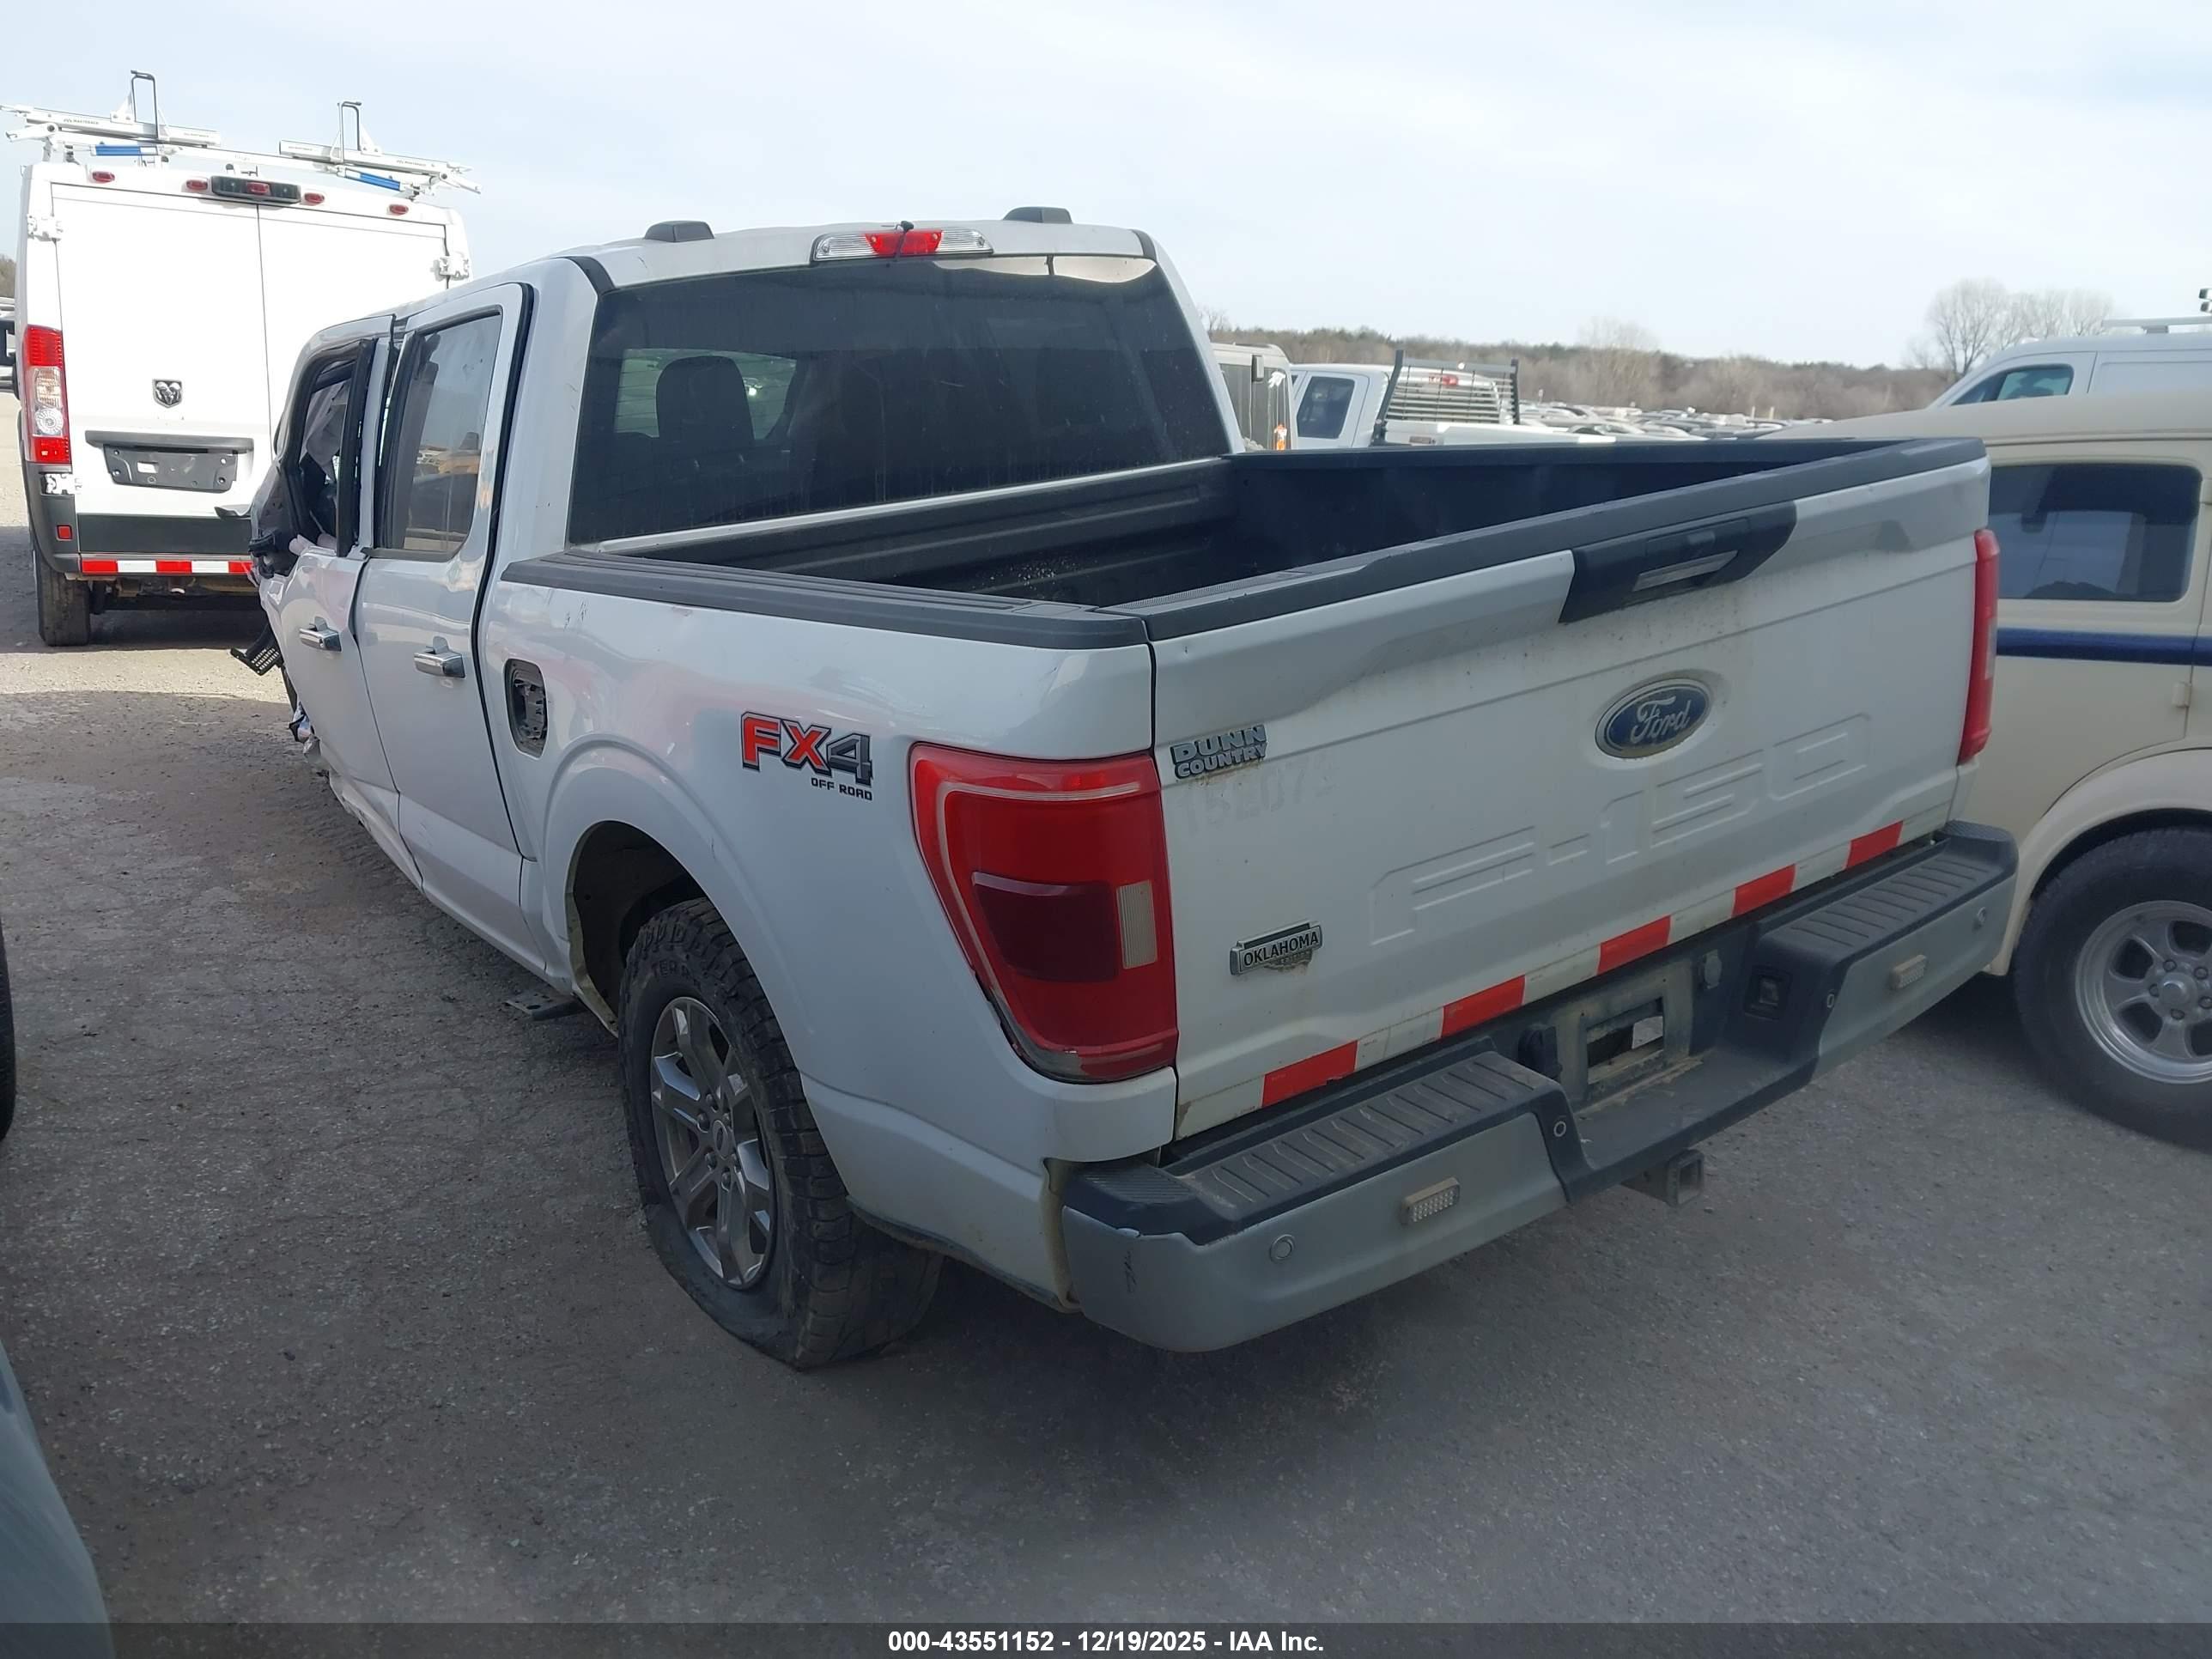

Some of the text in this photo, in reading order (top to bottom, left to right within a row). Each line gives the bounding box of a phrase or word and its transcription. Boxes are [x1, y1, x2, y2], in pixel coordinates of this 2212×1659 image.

[1631, 696, 1692, 744] Ford
[740, 711, 874, 788] FX4
[1170, 724, 1267, 764] DUNN
[1175, 742, 1267, 779] COUNTRY
[811, 777, 872, 800] OFF ROAD
[1369, 712, 1872, 946] F-150
[1243, 931, 1319, 966] OKLAHOMA
